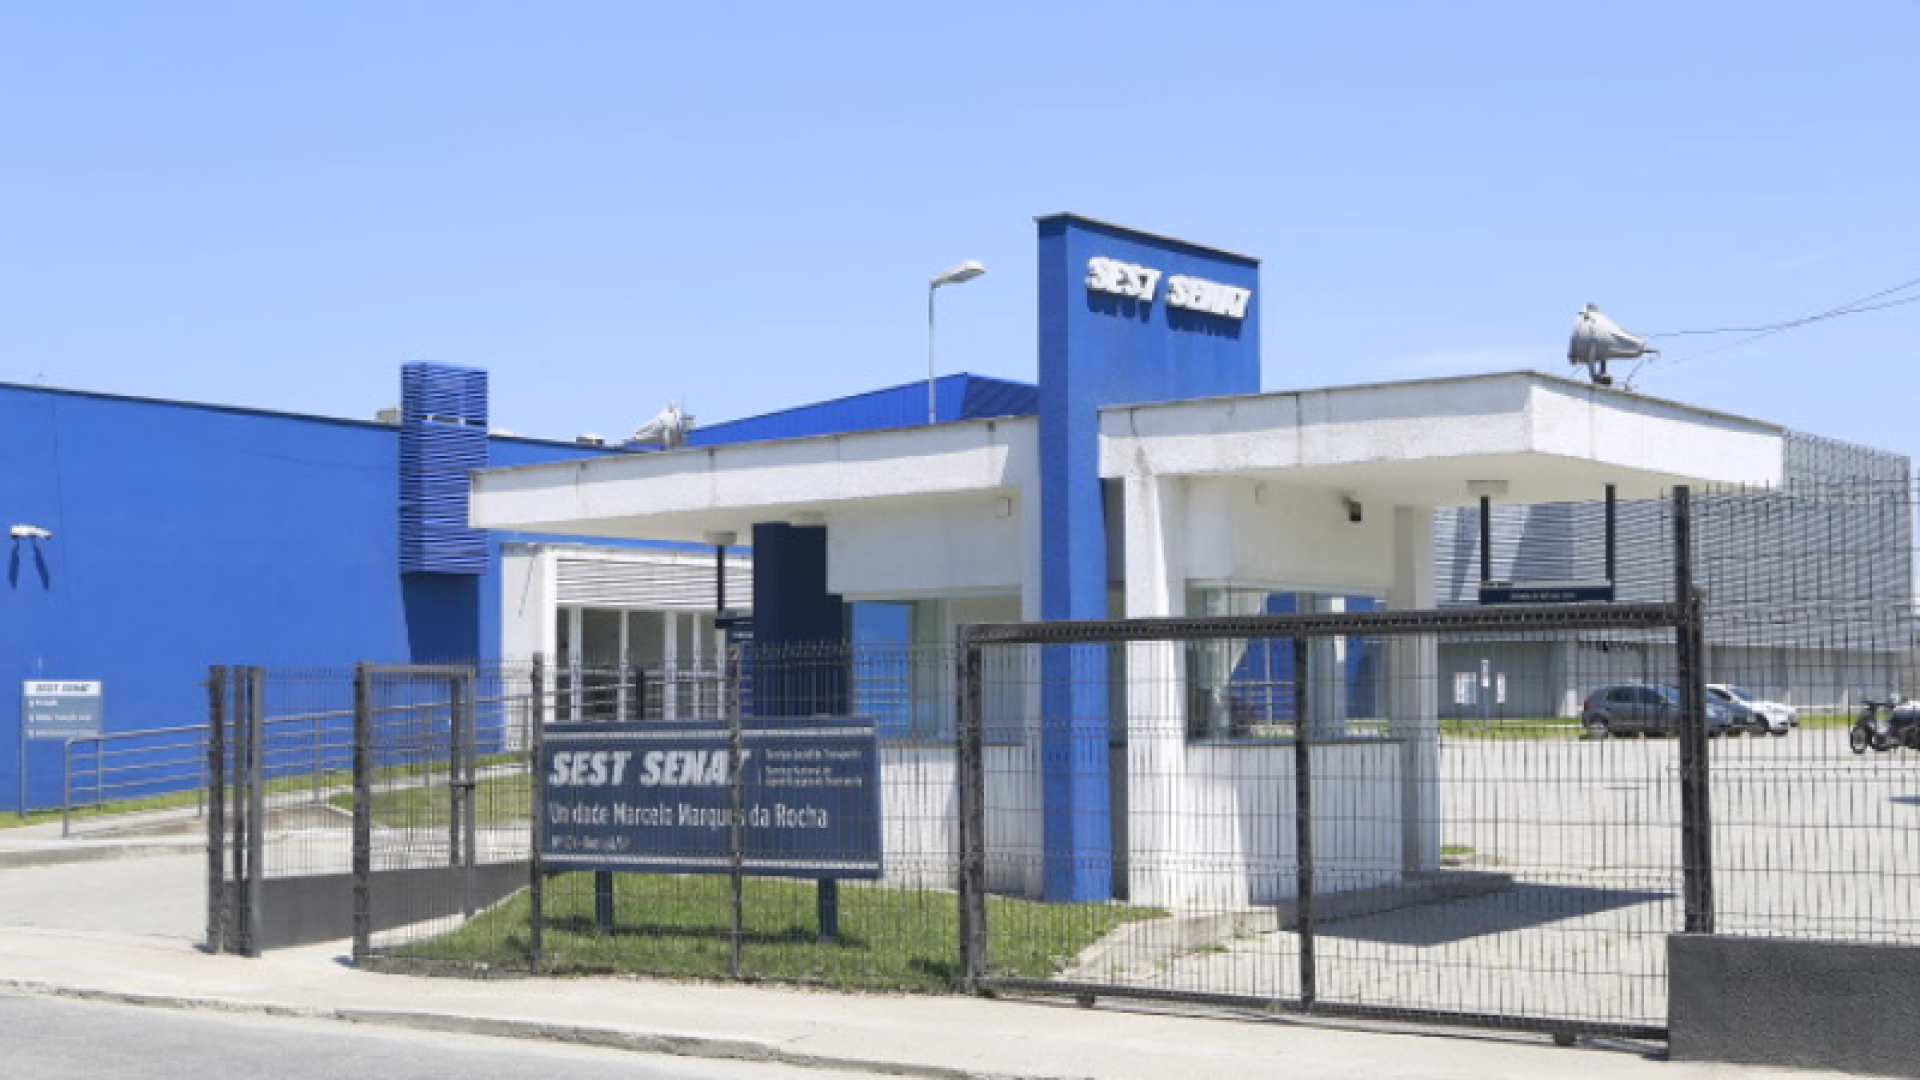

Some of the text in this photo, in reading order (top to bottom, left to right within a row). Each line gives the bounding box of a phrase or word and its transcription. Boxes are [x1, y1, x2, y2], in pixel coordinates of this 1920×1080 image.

[1085, 256, 1251, 319] SEST SENAT
[549, 750, 632, 786] SEST
[613, 802, 673, 826] Marcelo
[749, 803, 771, 828] da
[774, 803, 829, 828] Rocha
